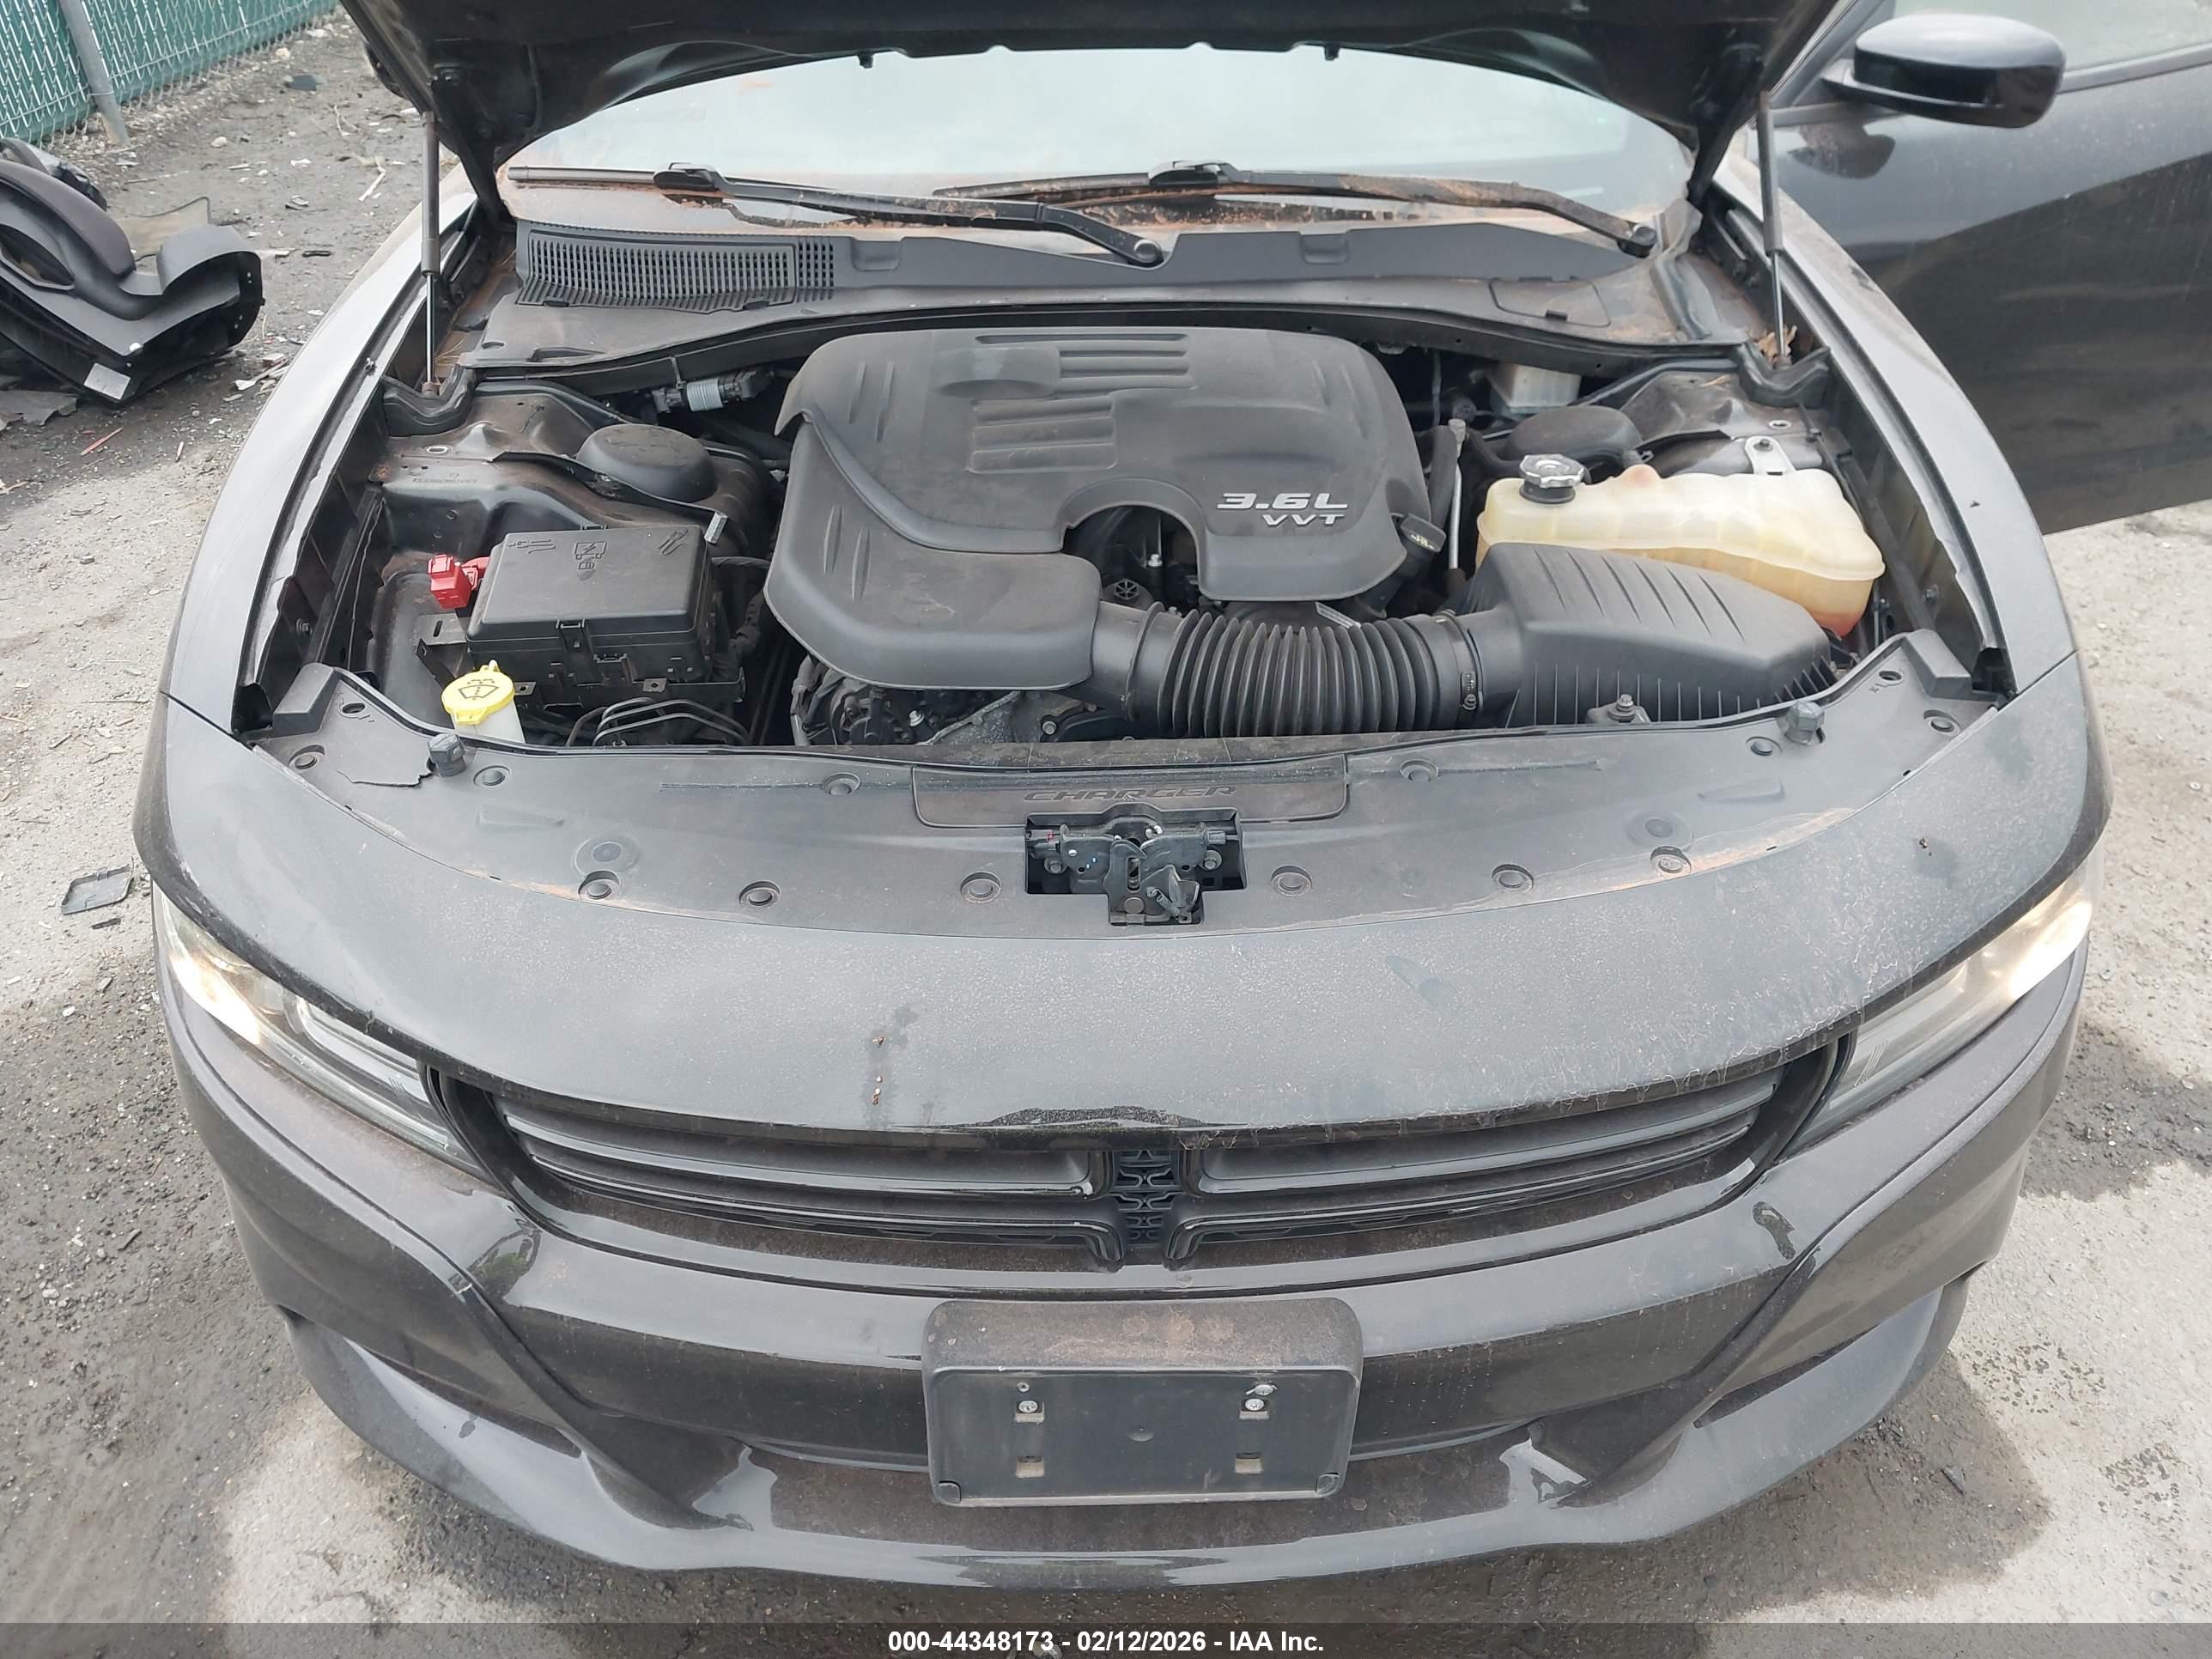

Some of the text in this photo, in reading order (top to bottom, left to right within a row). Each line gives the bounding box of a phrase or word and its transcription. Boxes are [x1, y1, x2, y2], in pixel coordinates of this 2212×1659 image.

[1216, 492, 1349, 510] 3.6L
[1261, 514, 1346, 526] VVT
[1023, 785, 1238, 802] CHARGER
